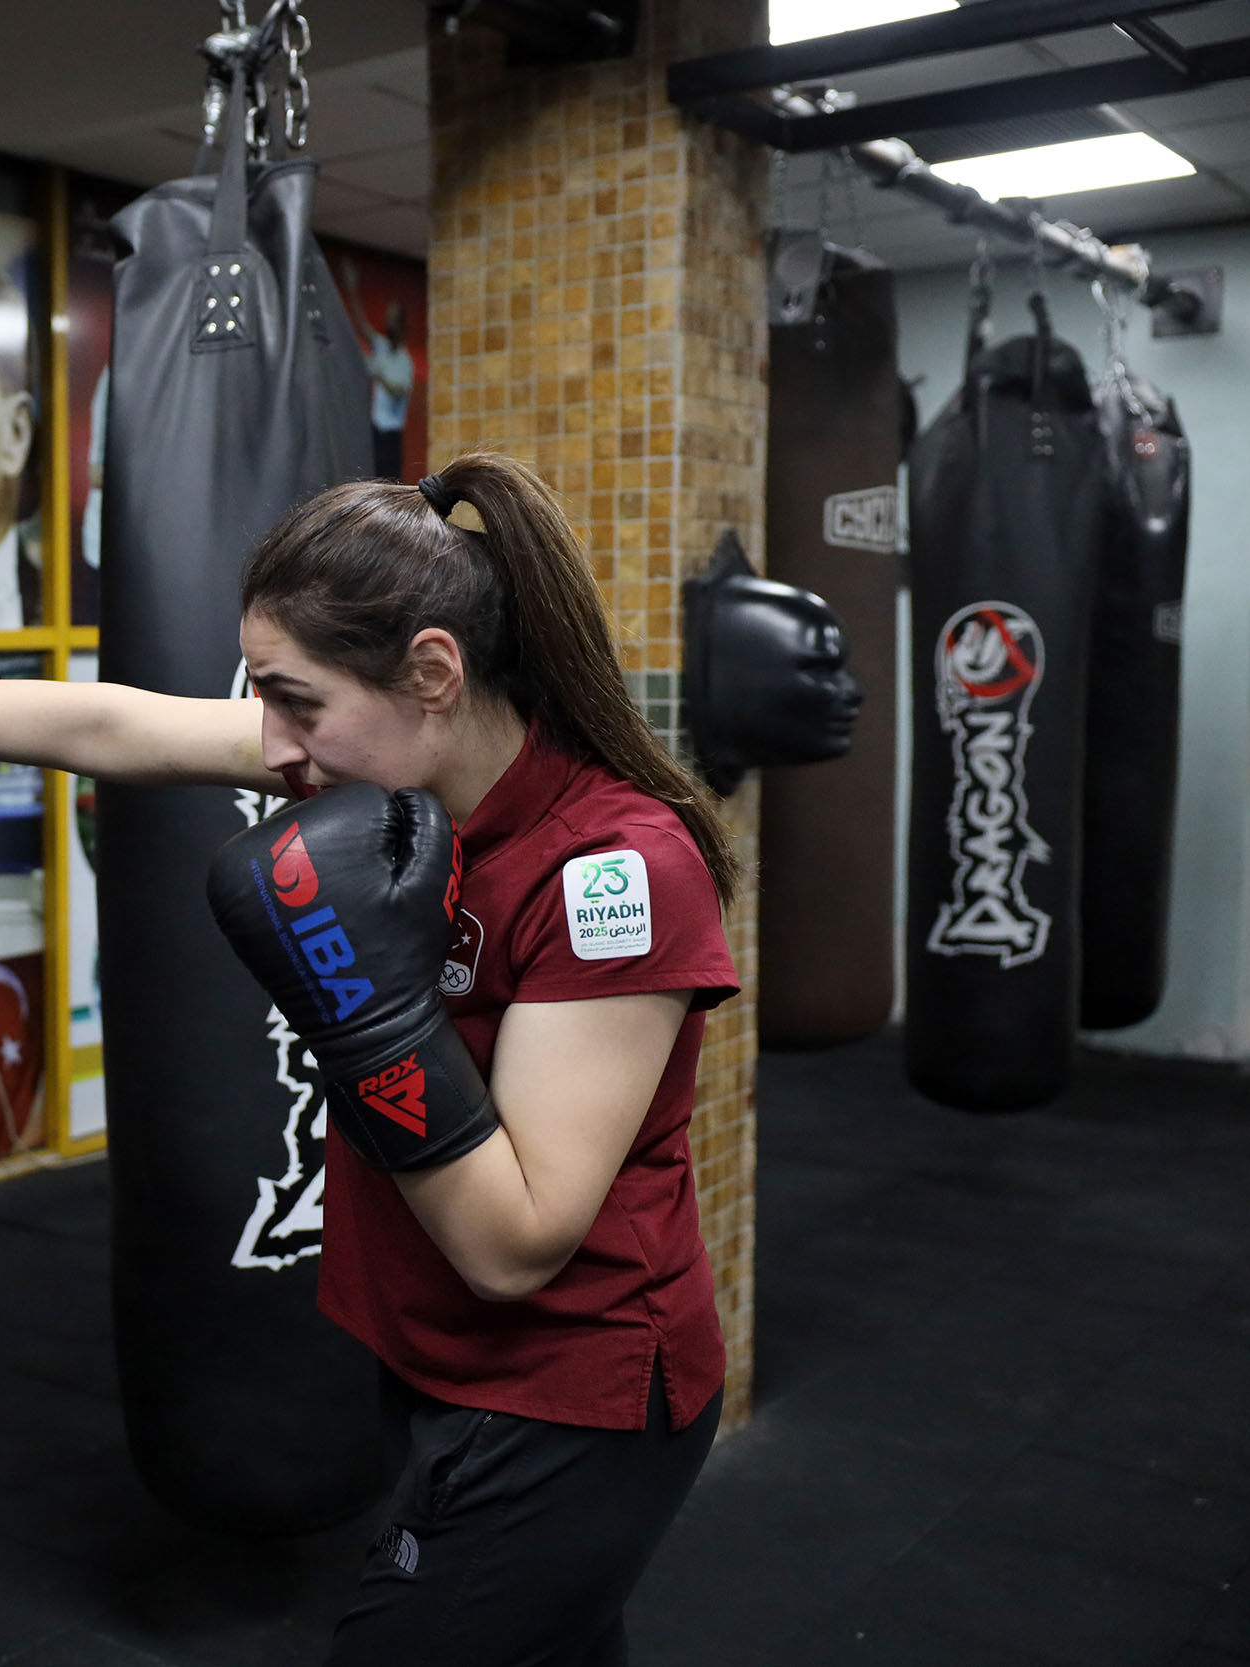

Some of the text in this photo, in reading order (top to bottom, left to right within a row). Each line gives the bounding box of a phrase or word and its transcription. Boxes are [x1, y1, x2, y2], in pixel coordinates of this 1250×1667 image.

[576, 901, 644, 924] RIYADH
[579, 927, 608, 938] 2025
[290, 905, 375, 1022] IBA
[358, 1052, 419, 1097] RDX
